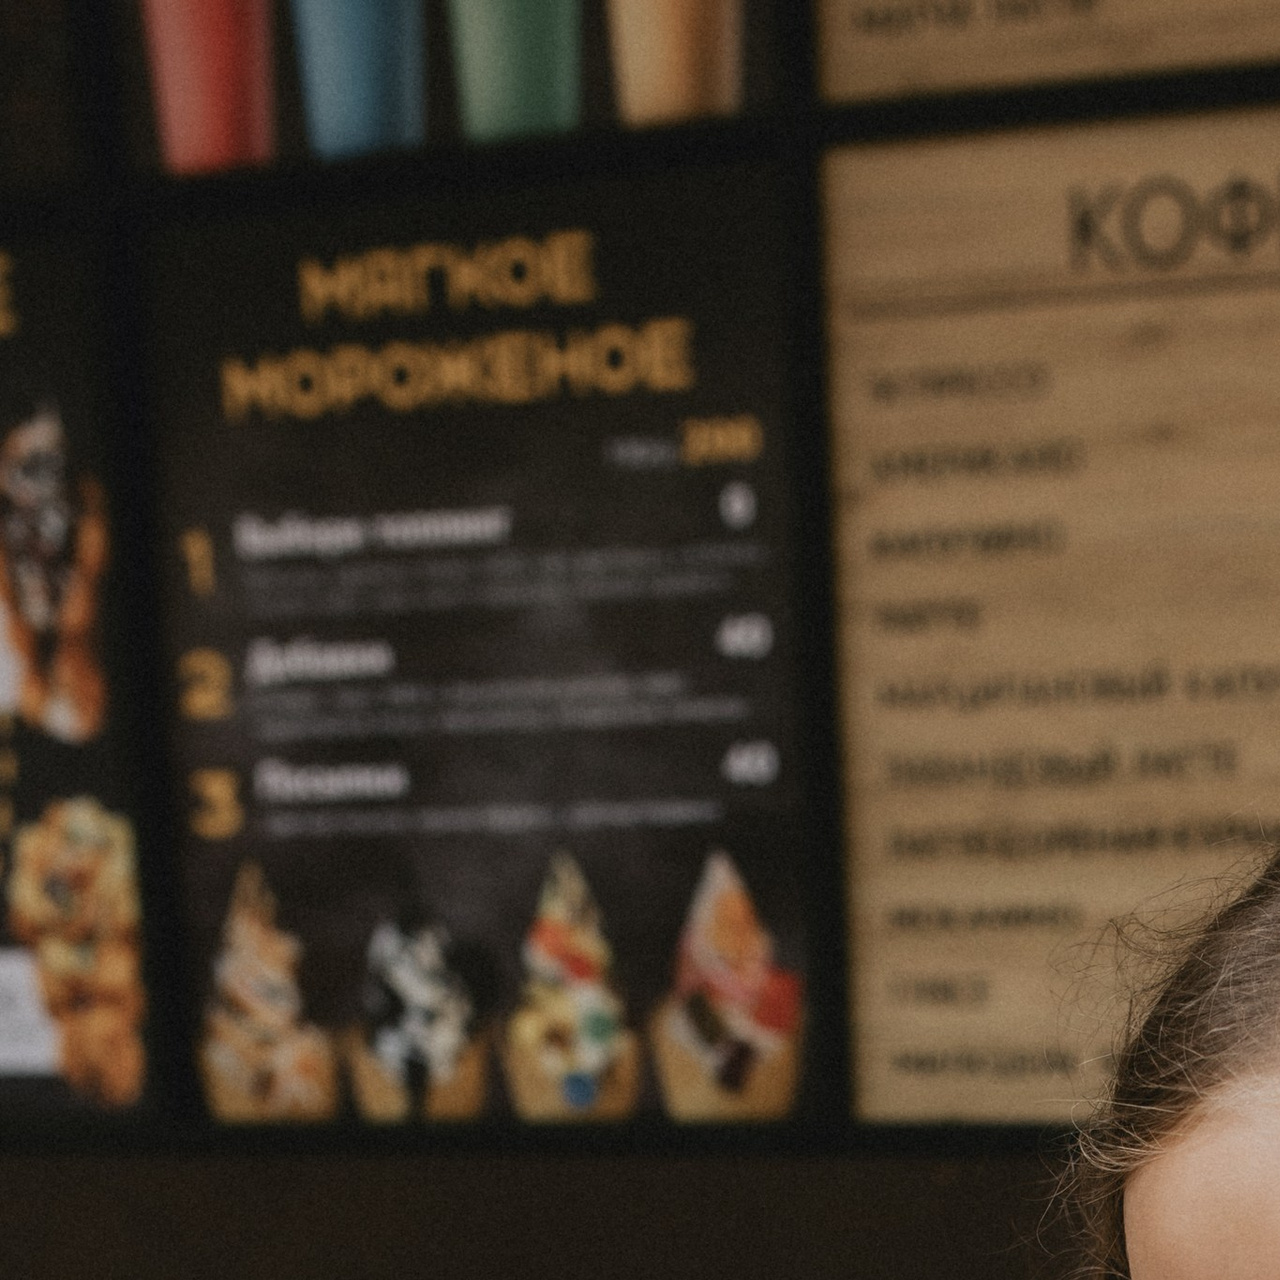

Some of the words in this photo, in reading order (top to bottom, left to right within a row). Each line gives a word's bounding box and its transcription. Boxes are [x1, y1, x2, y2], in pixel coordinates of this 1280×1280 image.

[300, 229, 594, 320] МЯГКОЕ
[223, 319, 693, 417] МОРОЖЕНОЕ
[181, 651, 231, 718] 2
[192, 771, 242, 838] 3
